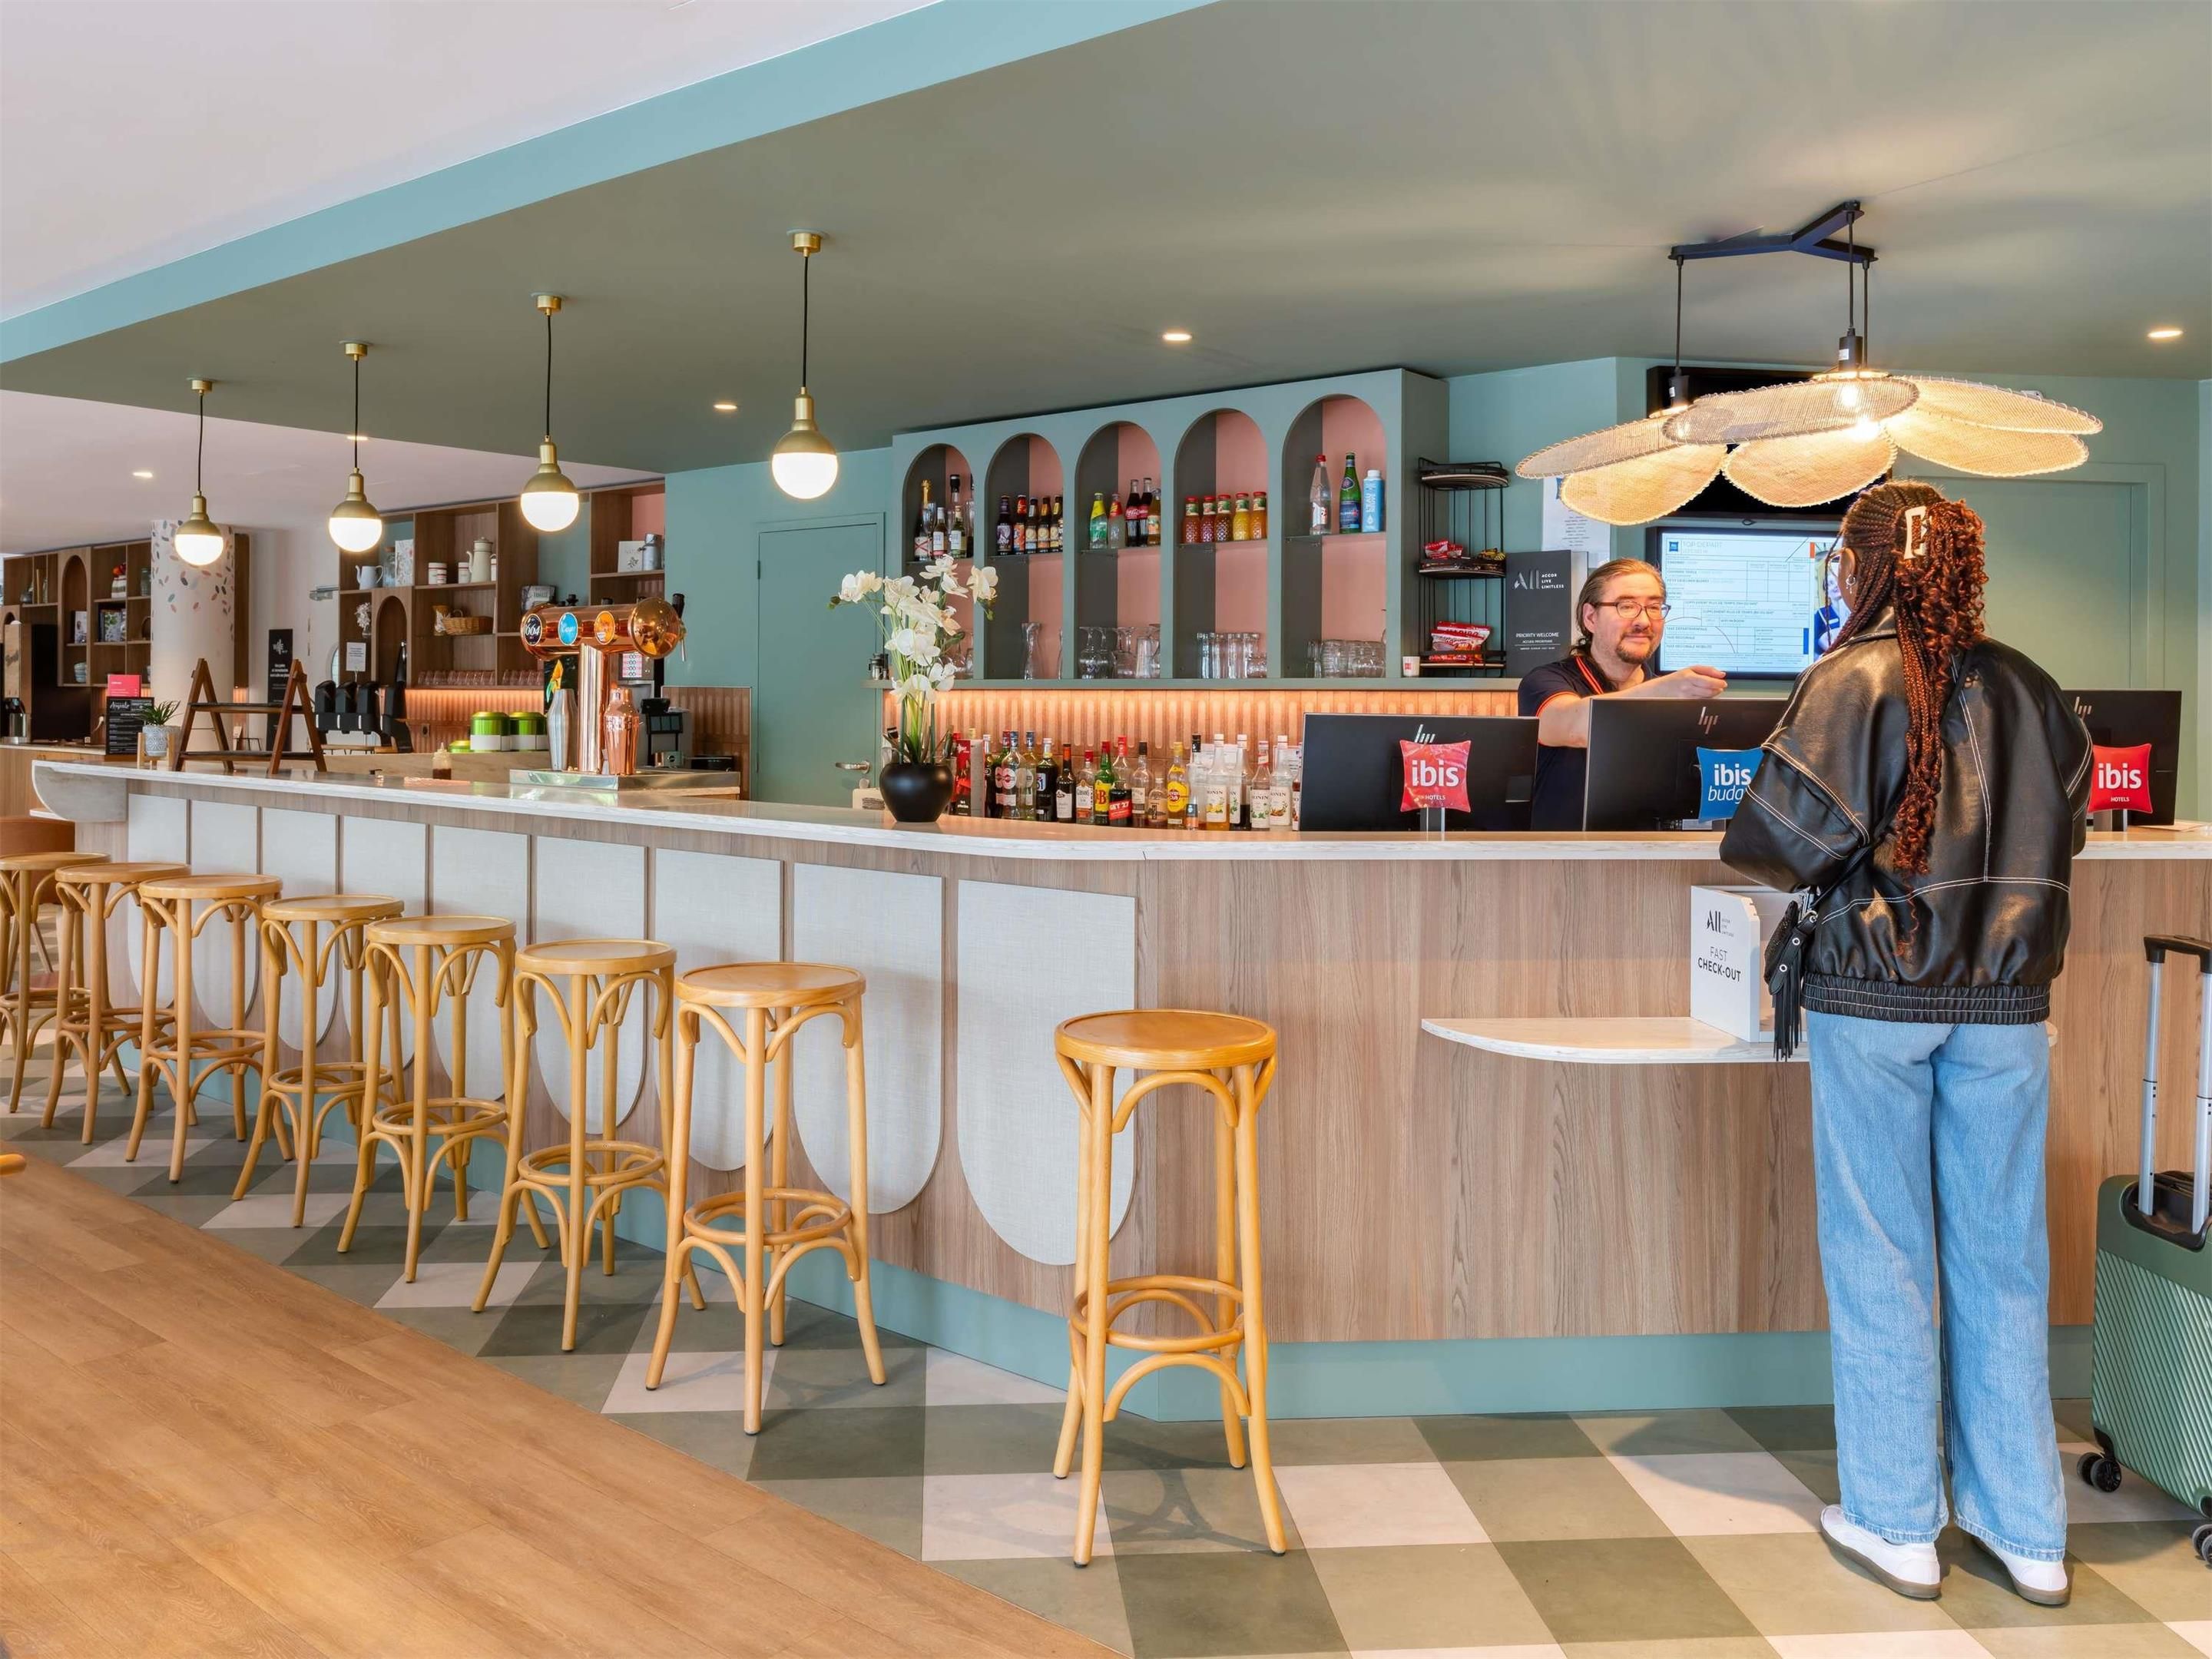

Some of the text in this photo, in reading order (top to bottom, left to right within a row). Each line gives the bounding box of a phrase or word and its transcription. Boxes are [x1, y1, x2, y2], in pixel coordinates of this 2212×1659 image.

[1698, 706, 1719, 735] hp
[1412, 760, 1459, 787] ibis
[1714, 763, 1752, 786] ibis
[2098, 763, 2142, 789] ibis
[1708, 785, 1744, 804] budg
[1707, 910, 1720, 933] All
[1710, 946, 1727, 962] FAST
[1697, 957, 1741, 982] CHECK-OUT
